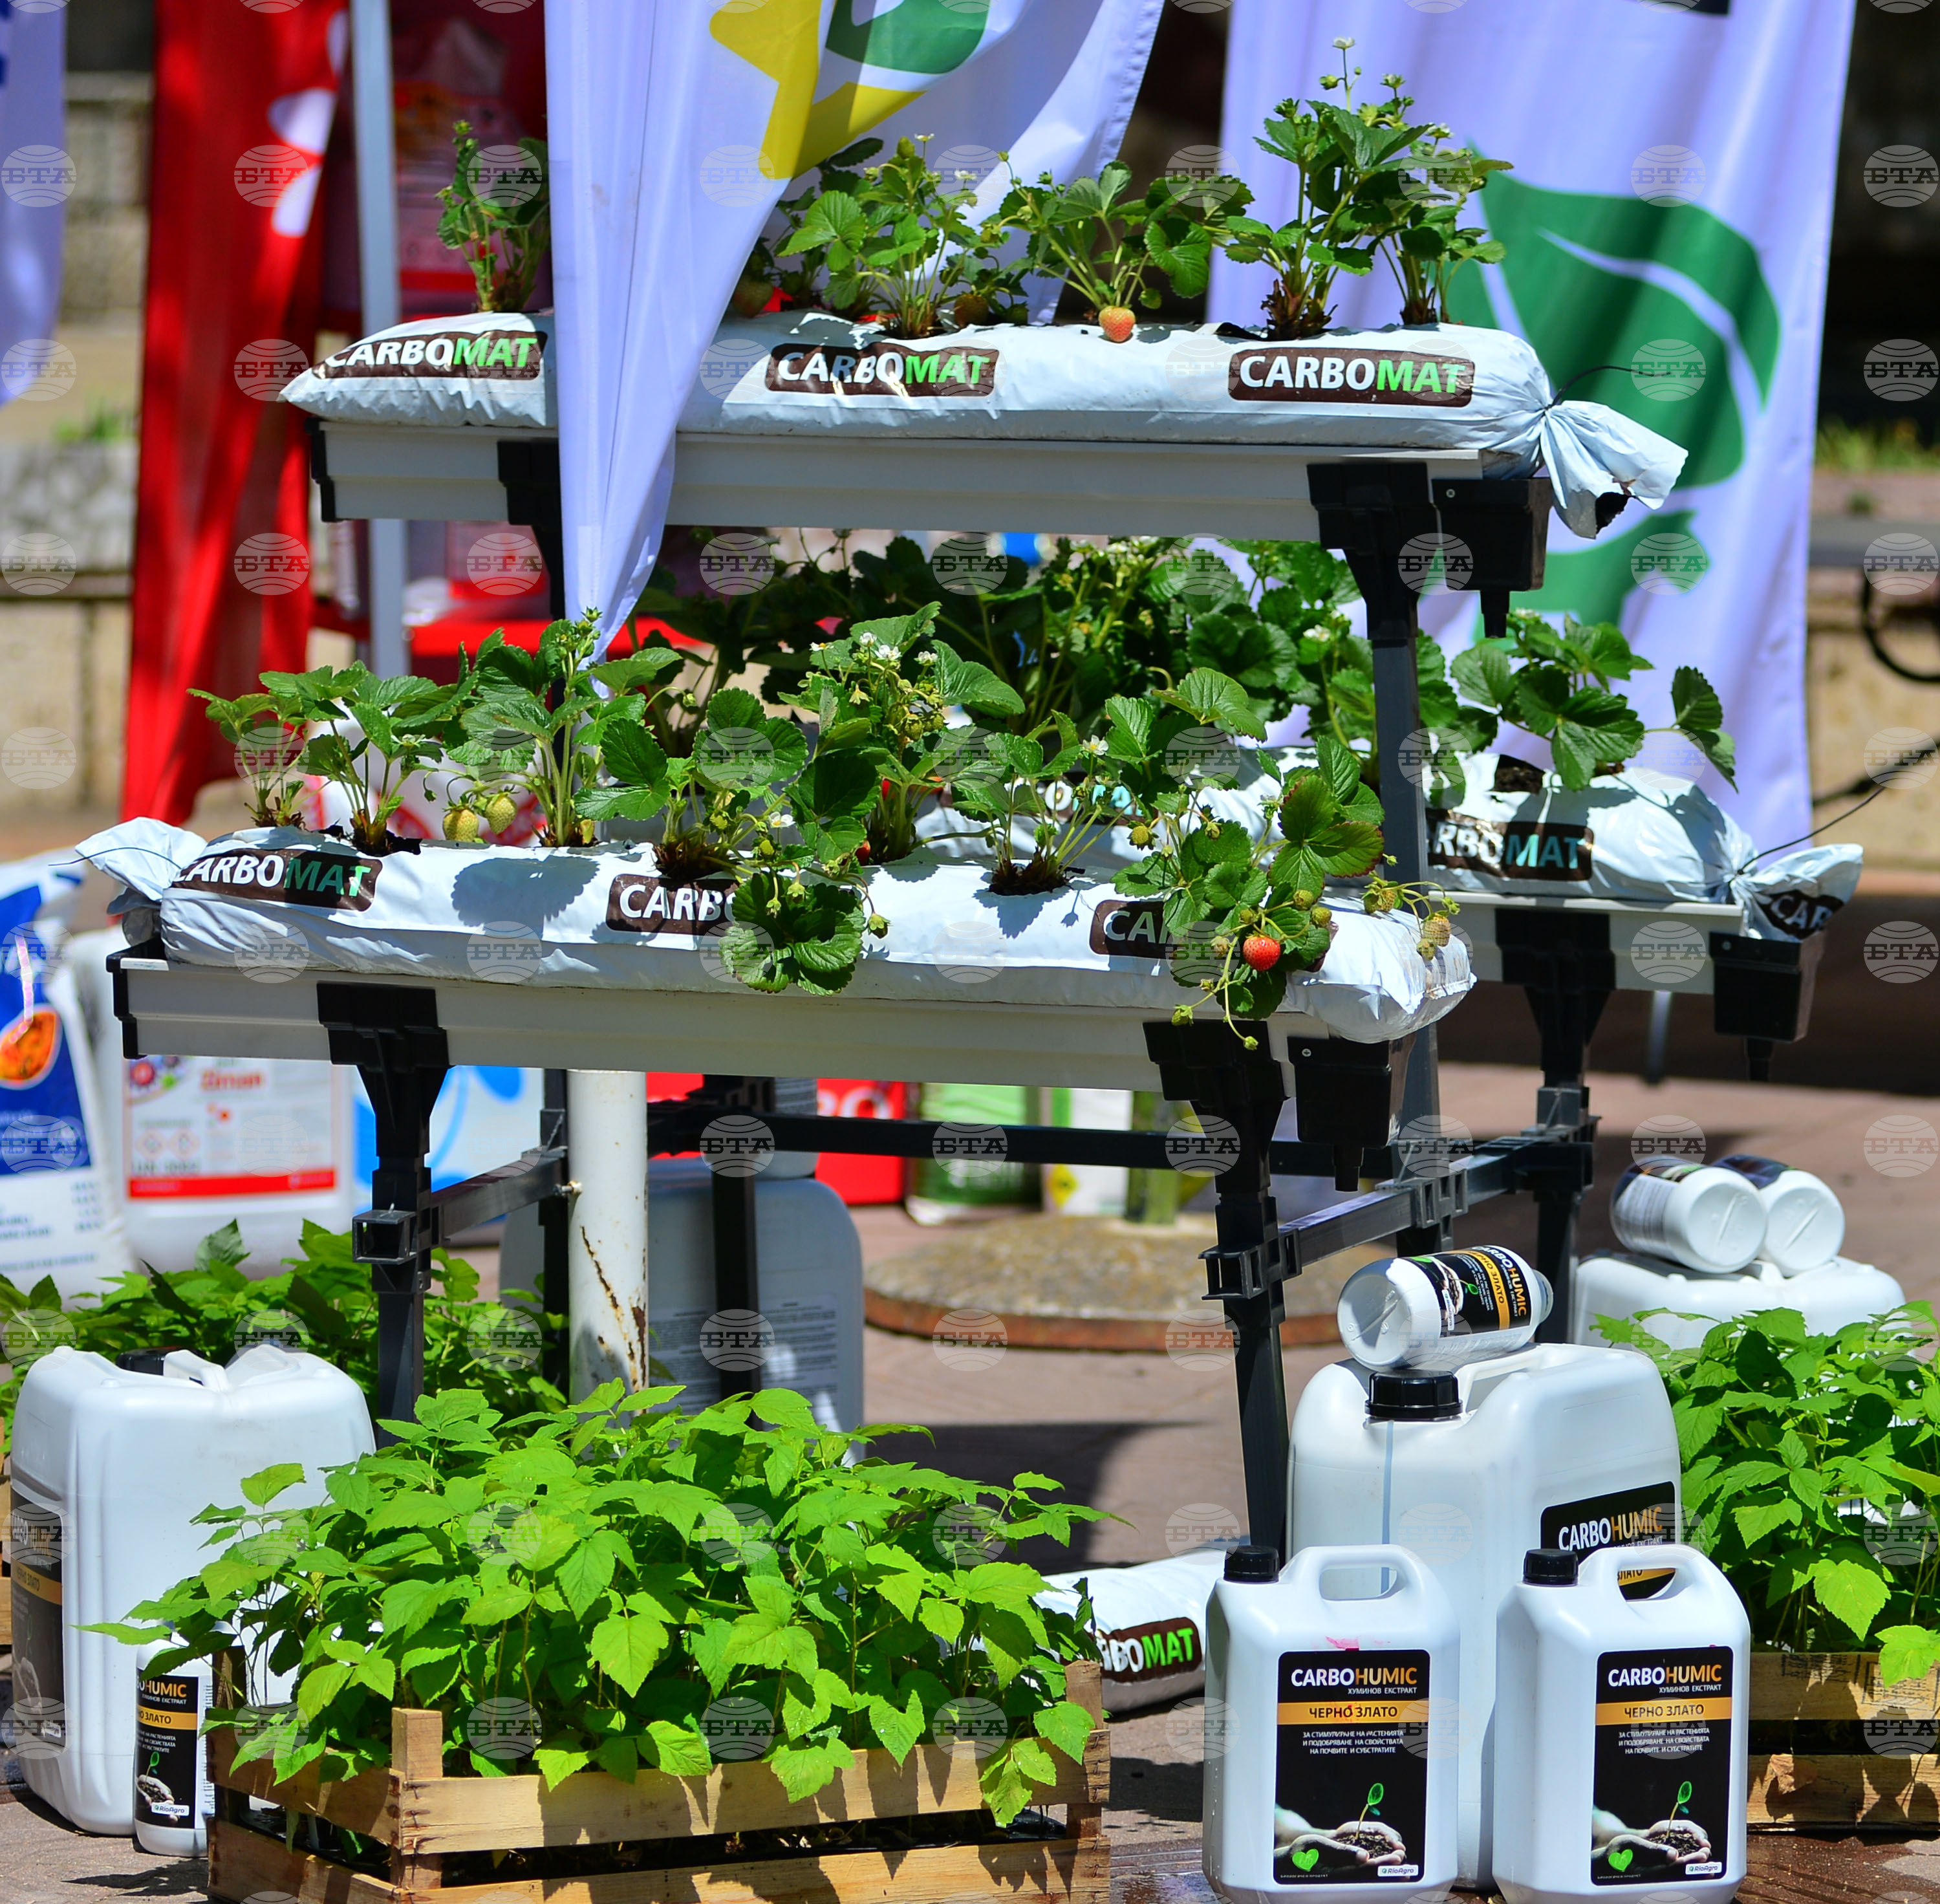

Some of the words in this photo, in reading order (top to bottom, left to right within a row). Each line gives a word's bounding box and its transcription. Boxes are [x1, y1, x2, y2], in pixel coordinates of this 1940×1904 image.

[777, 352, 991, 385] CARBOMAT
[1240, 355, 1465, 393] CARBOMAT
[1432, 821, 1586, 869] RBOMAT
[1491, 1270, 1505, 1304] ЗЛАТО
[1558, 1506, 1663, 1552] CARBOHUMIC
[1291, 1667, 1417, 1687] CARBOHUMIC
[1608, 1664, 1722, 1687] CARBOHUMIC
[1692, 1684, 1721, 1693] ЕКСТРАКТ
[145, 1711, 172, 1724] ЗЛАТО
[1309, 1707, 1353, 1718] ЧЕРНО
[1355, 1705, 1398, 1717] ЗЛАТО
[1624, 1705, 1663, 1718] ЧЕРНО
[1666, 1704, 1705, 1716] ЗЛАТО
[159, 1806, 185, 1814] RioAgro
